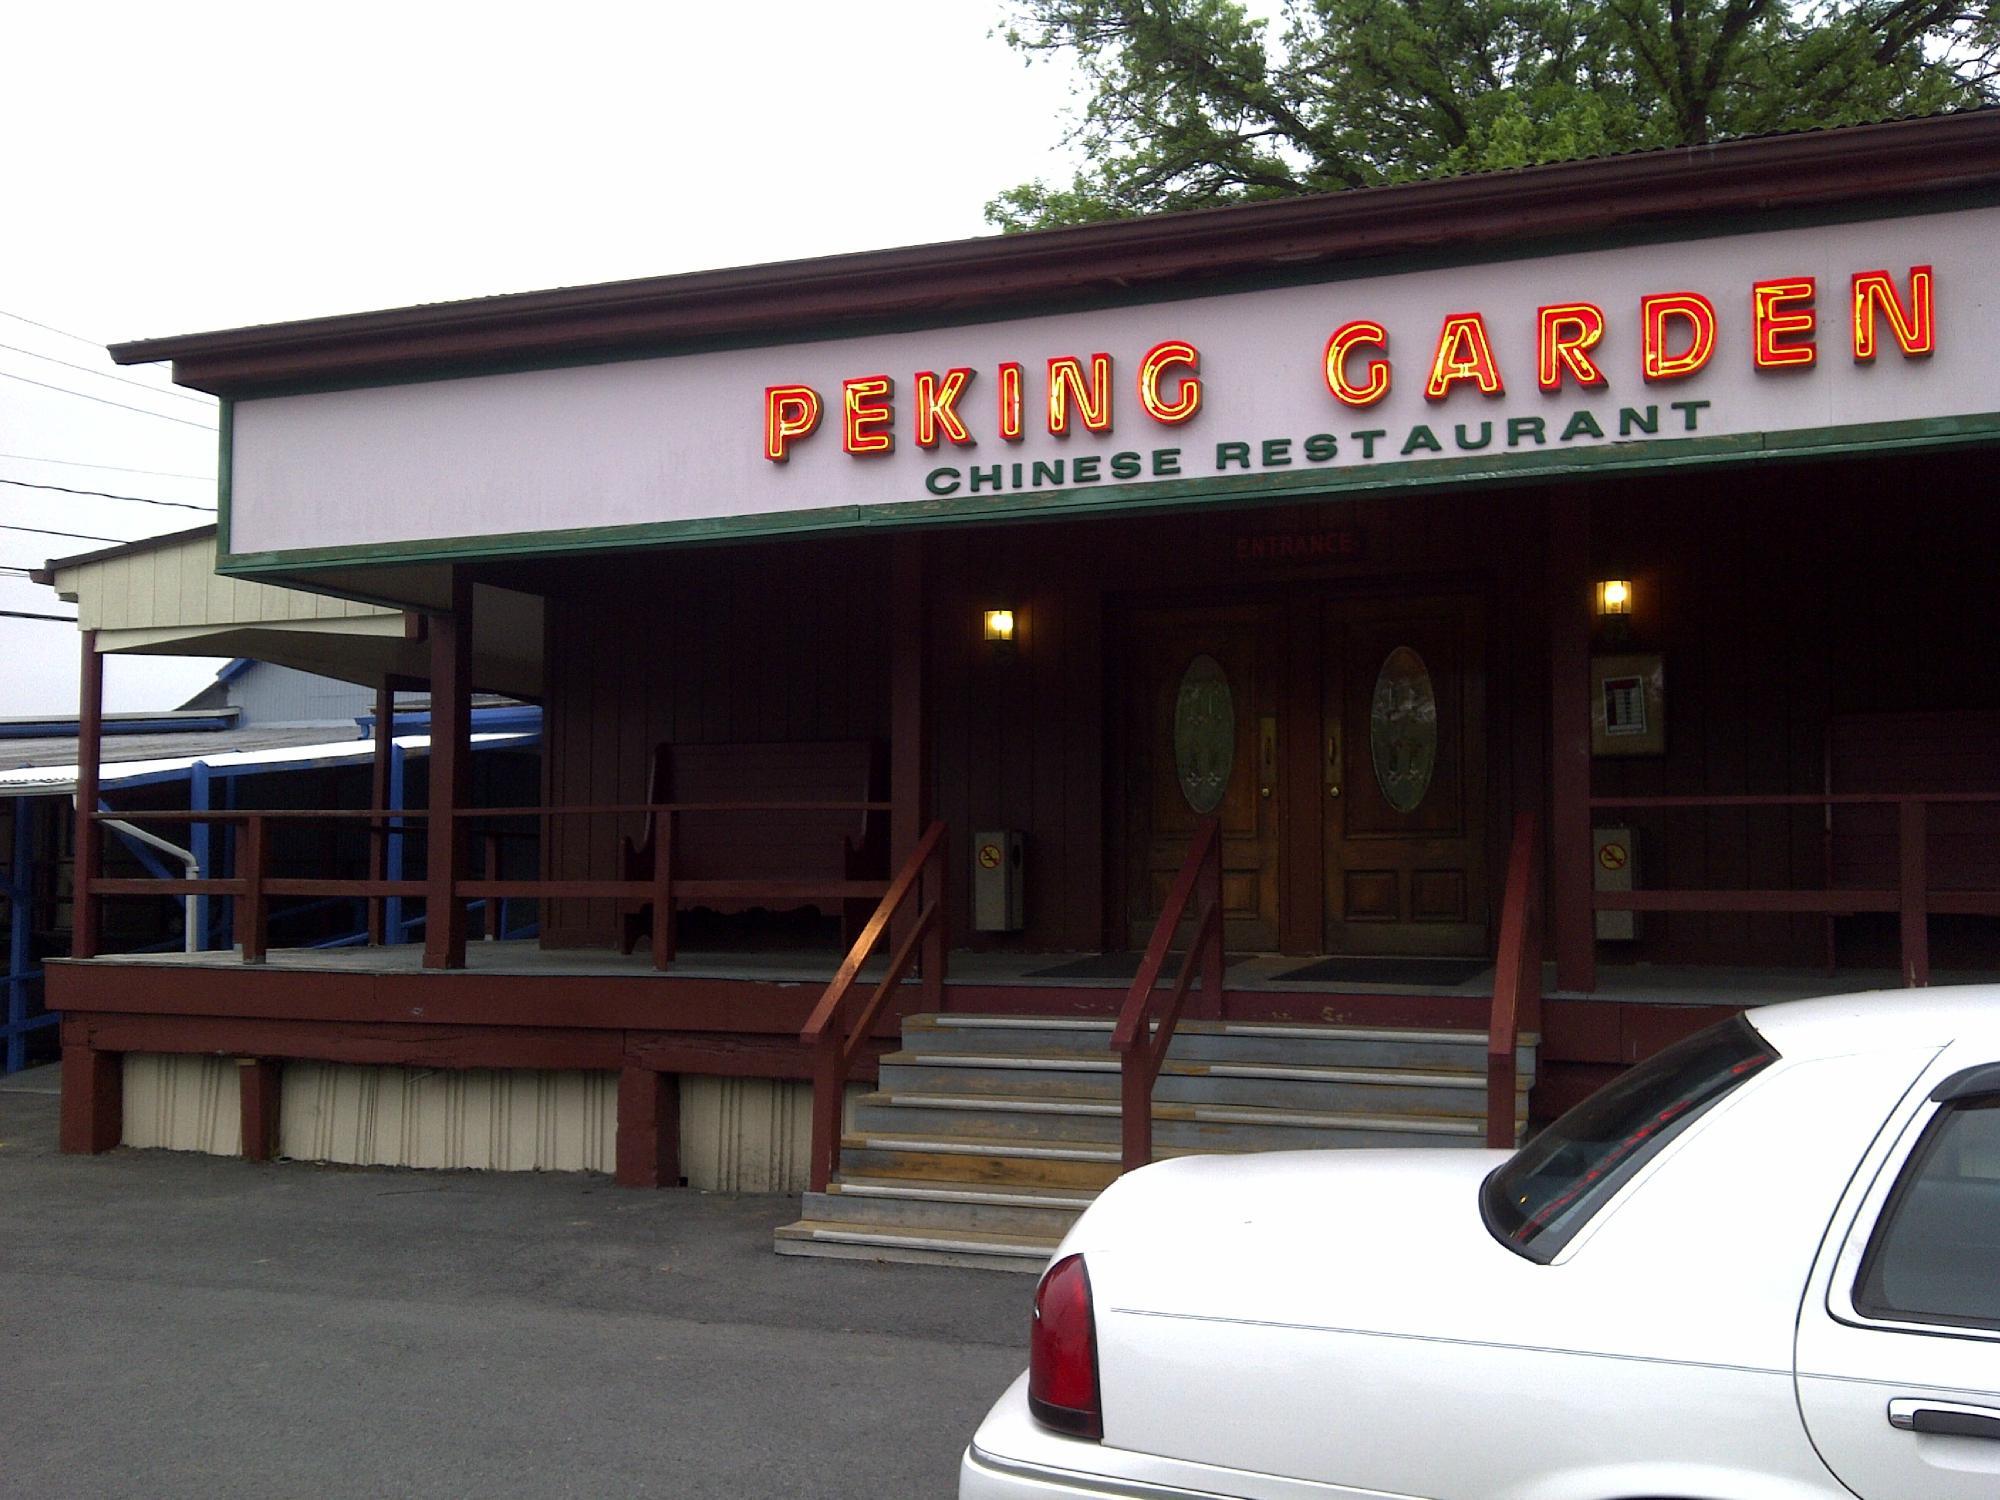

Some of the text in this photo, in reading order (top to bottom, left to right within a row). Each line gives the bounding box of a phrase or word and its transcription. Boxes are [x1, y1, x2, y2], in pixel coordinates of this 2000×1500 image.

[765, 265, 1935, 463] PEKING GARDEN
[925, 400, 1711, 495] CHINESE RESTAURANT
[1236, 532, 1352, 558] ENTRANCE
